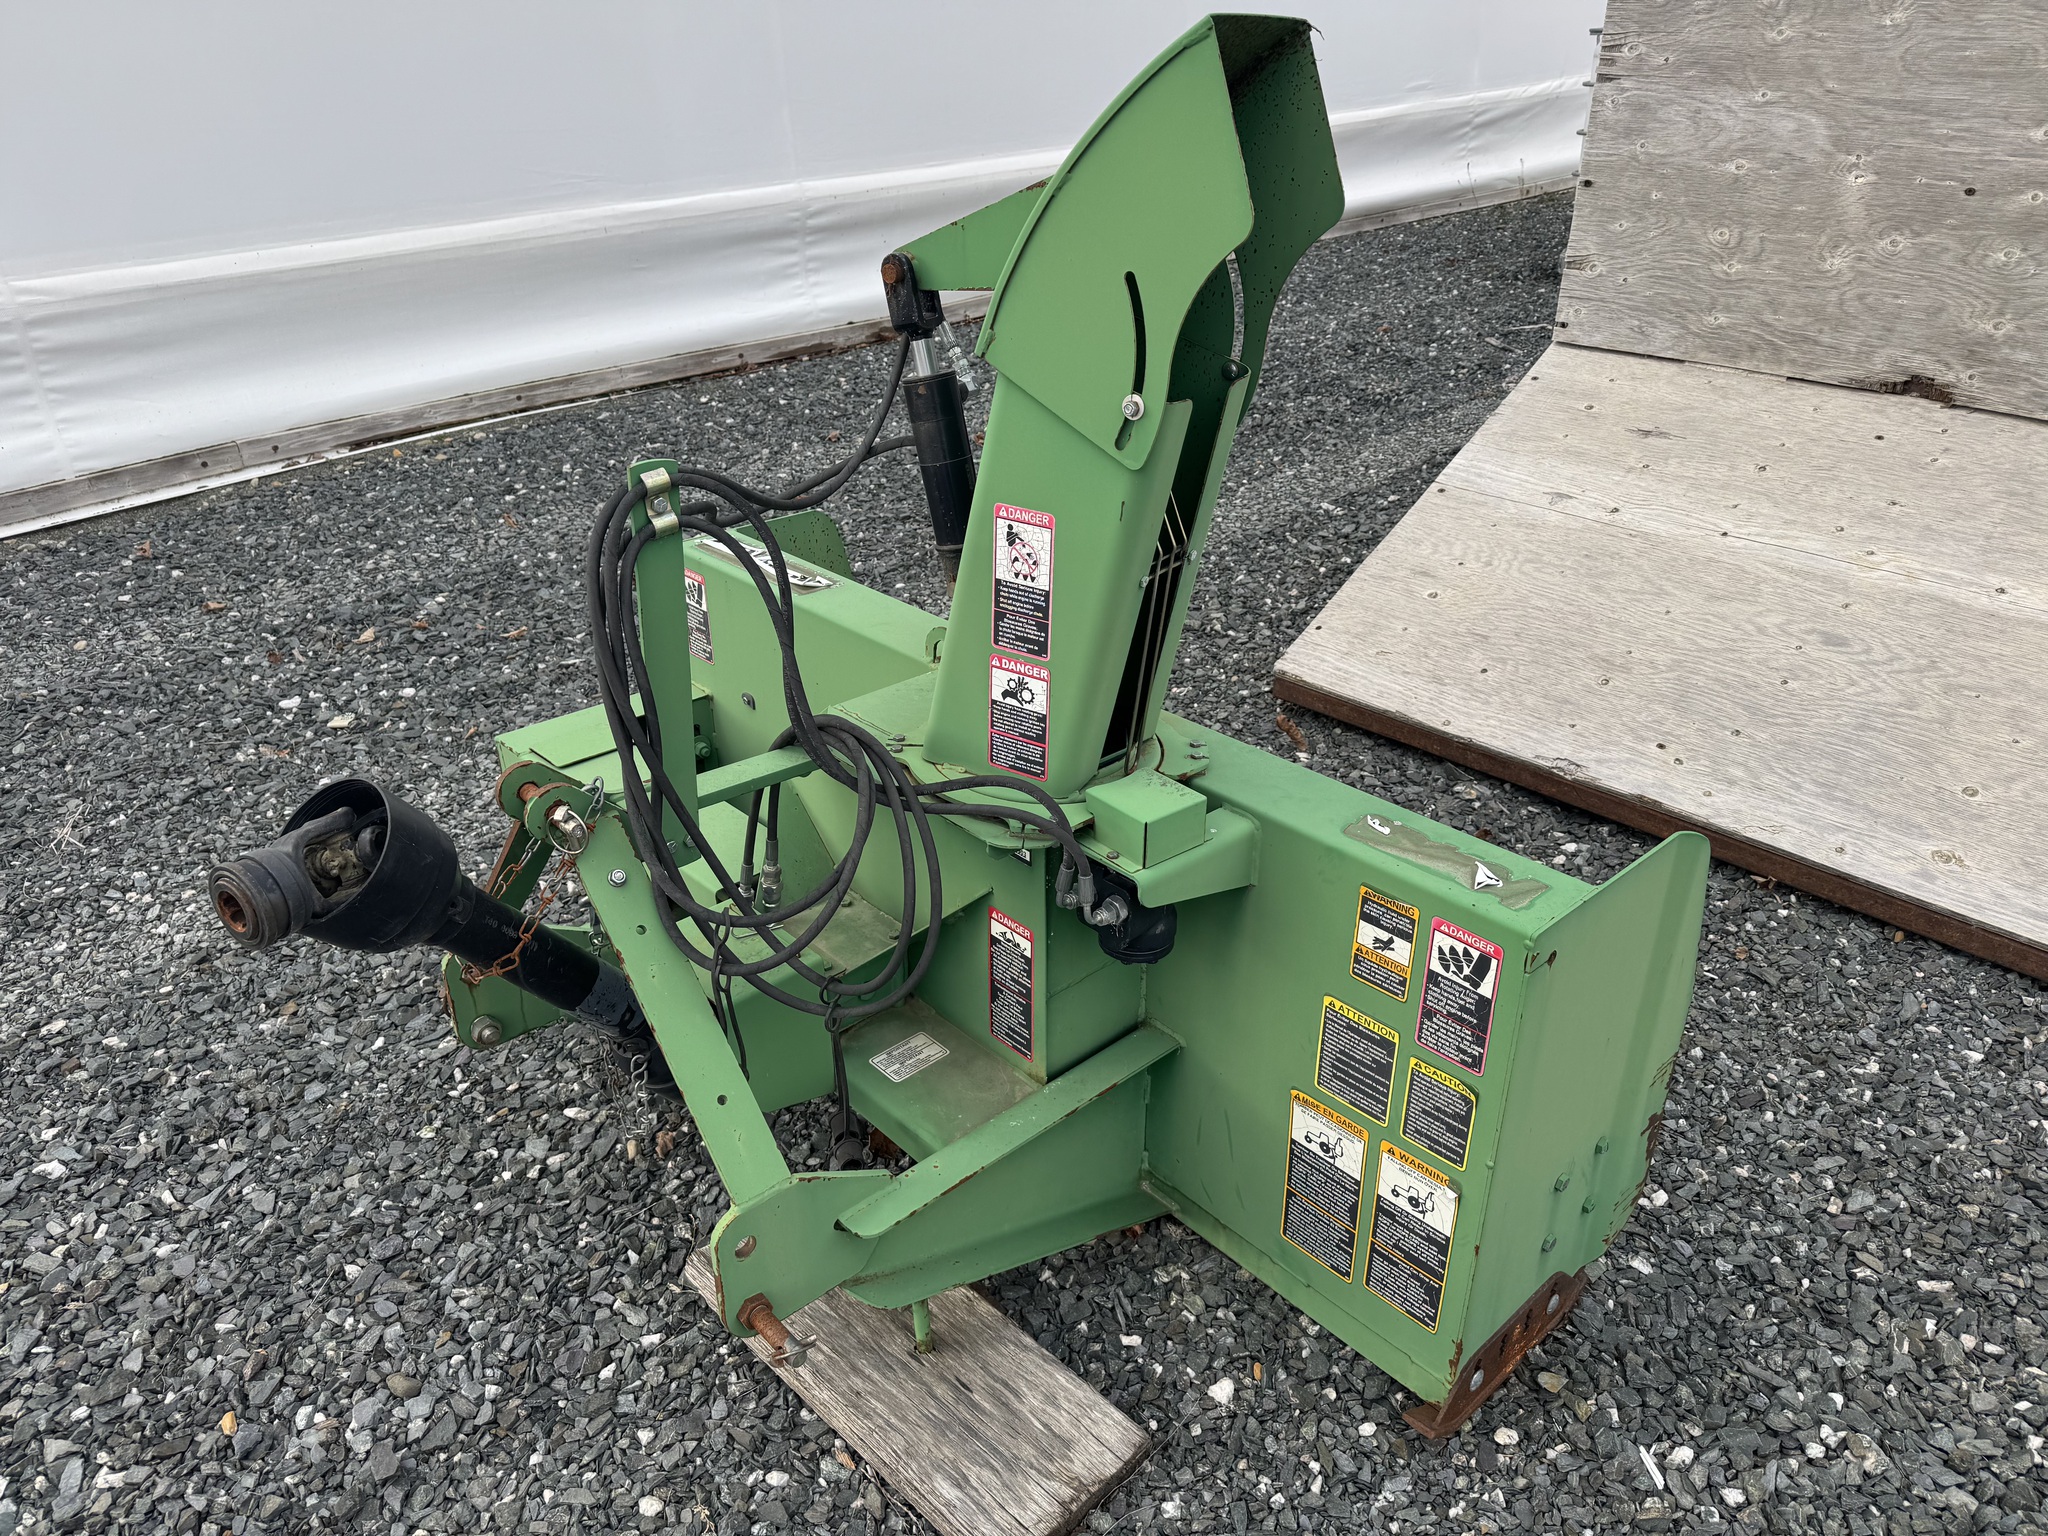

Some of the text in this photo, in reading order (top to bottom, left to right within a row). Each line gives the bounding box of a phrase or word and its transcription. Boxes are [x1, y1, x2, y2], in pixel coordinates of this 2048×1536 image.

[1008, 508, 1049, 525] DANGER
[1001, 658, 1048, 680] DANGER
[1370, 891, 1415, 917] WARNING
[1000, 913, 1030, 939] DANGER
[1449, 925, 1495, 954] DANGER
[1364, 949, 1407, 975] ATTENTION
[1427, 988, 1460, 1010] clothing away.
[1428, 982, 1441, 993] Keep
[1465, 1001, 1475, 1010] and
[1437, 975, 1479, 1000] Avoid Injury From
[1439, 981, 1459, 997] Rotating
[1426, 993, 1477, 1023] Shut off engine before
[1337, 1003, 1395, 1040] ATTENTION
[884, 1040, 911, 1056] IMPORTANT
[897, 1050, 924, 1066] IMPORTANT
[1301, 1095, 1364, 1138] MISE EN GARDE
